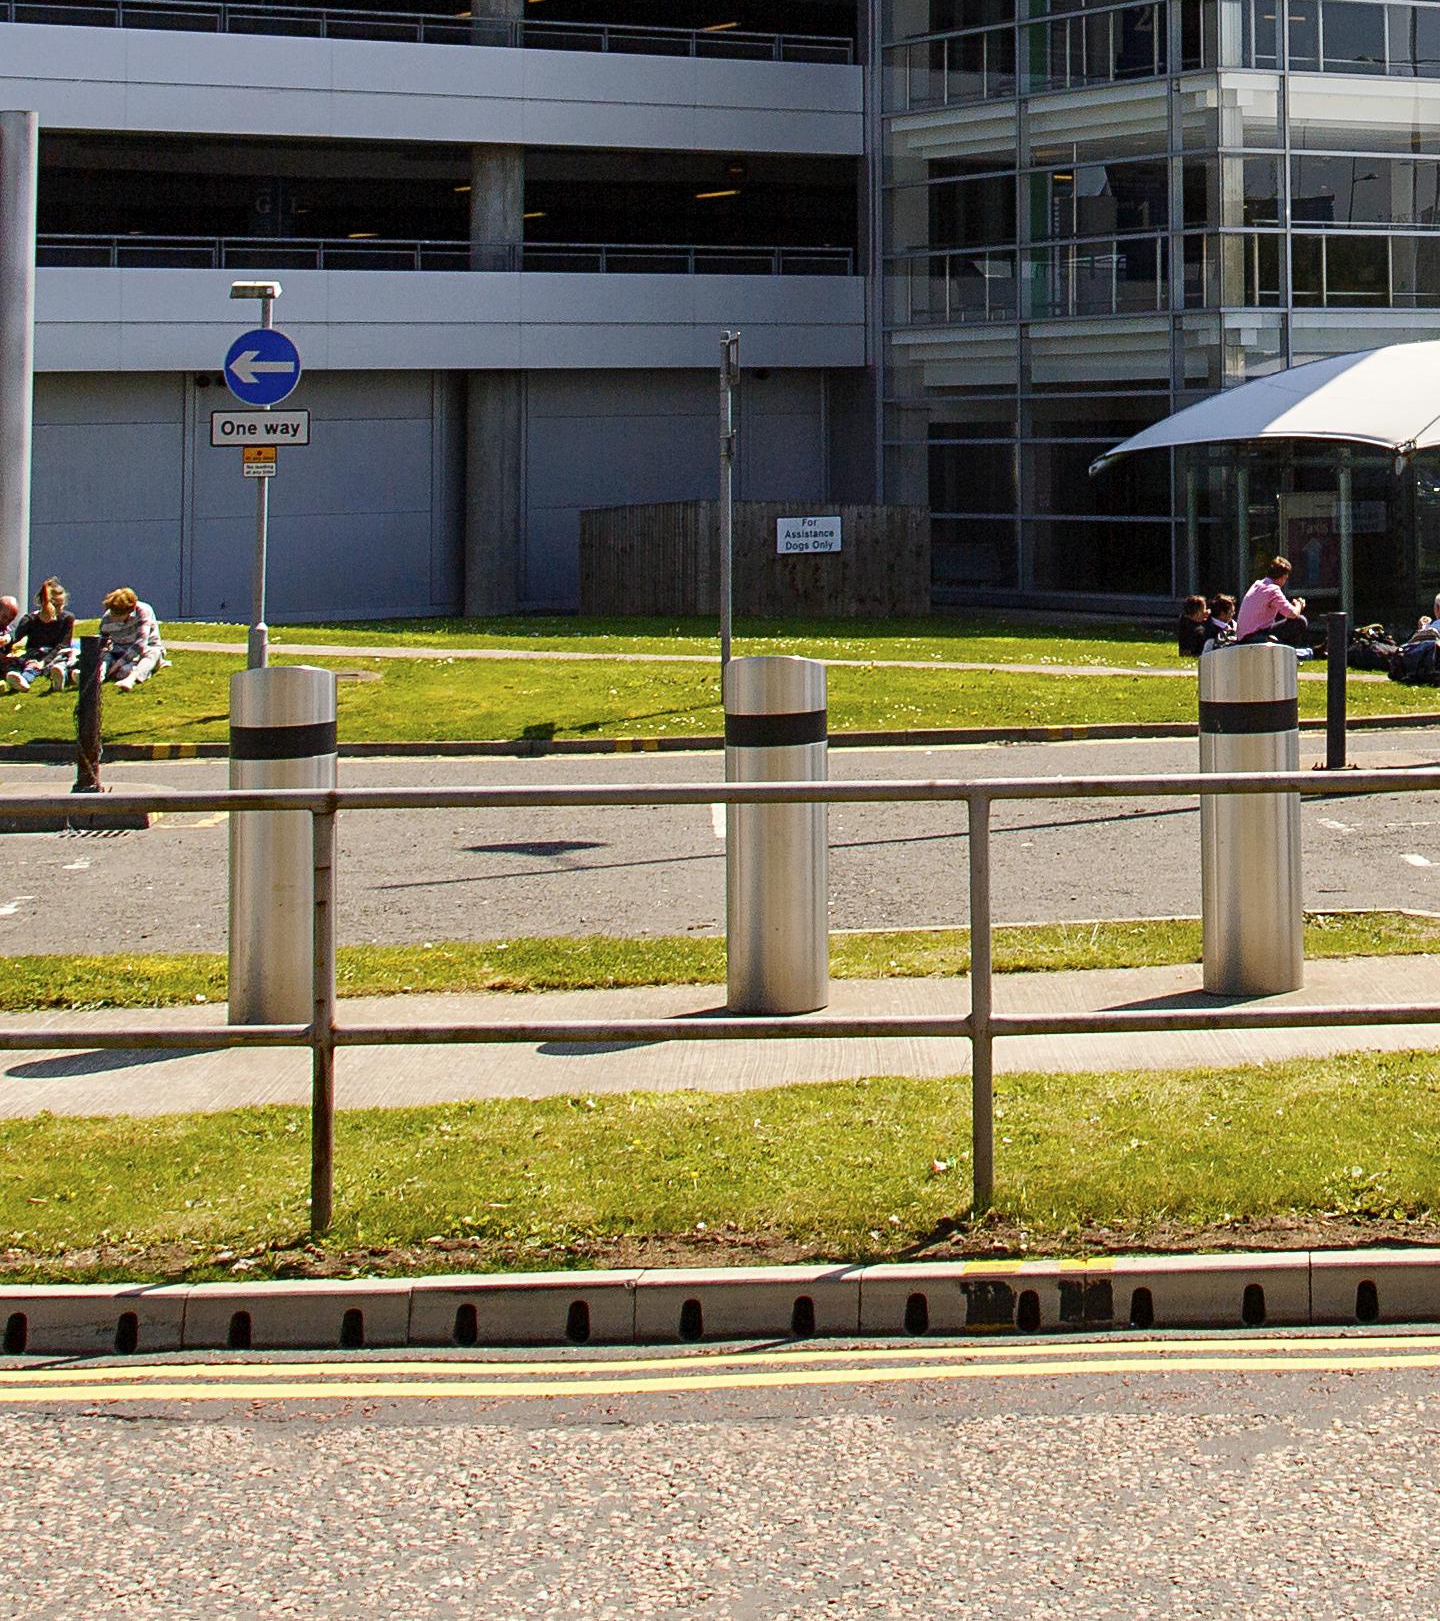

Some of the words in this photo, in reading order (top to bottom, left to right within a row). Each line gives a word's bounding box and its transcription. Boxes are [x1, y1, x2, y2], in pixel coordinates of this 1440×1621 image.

[221, 420, 258, 436] One
[264, 421, 300, 437] way
[802, 518, 818, 527] For
[784, 529, 835, 538] Assistance
[785, 541, 809, 551] Dogs
[812, 540, 833, 551] Only
